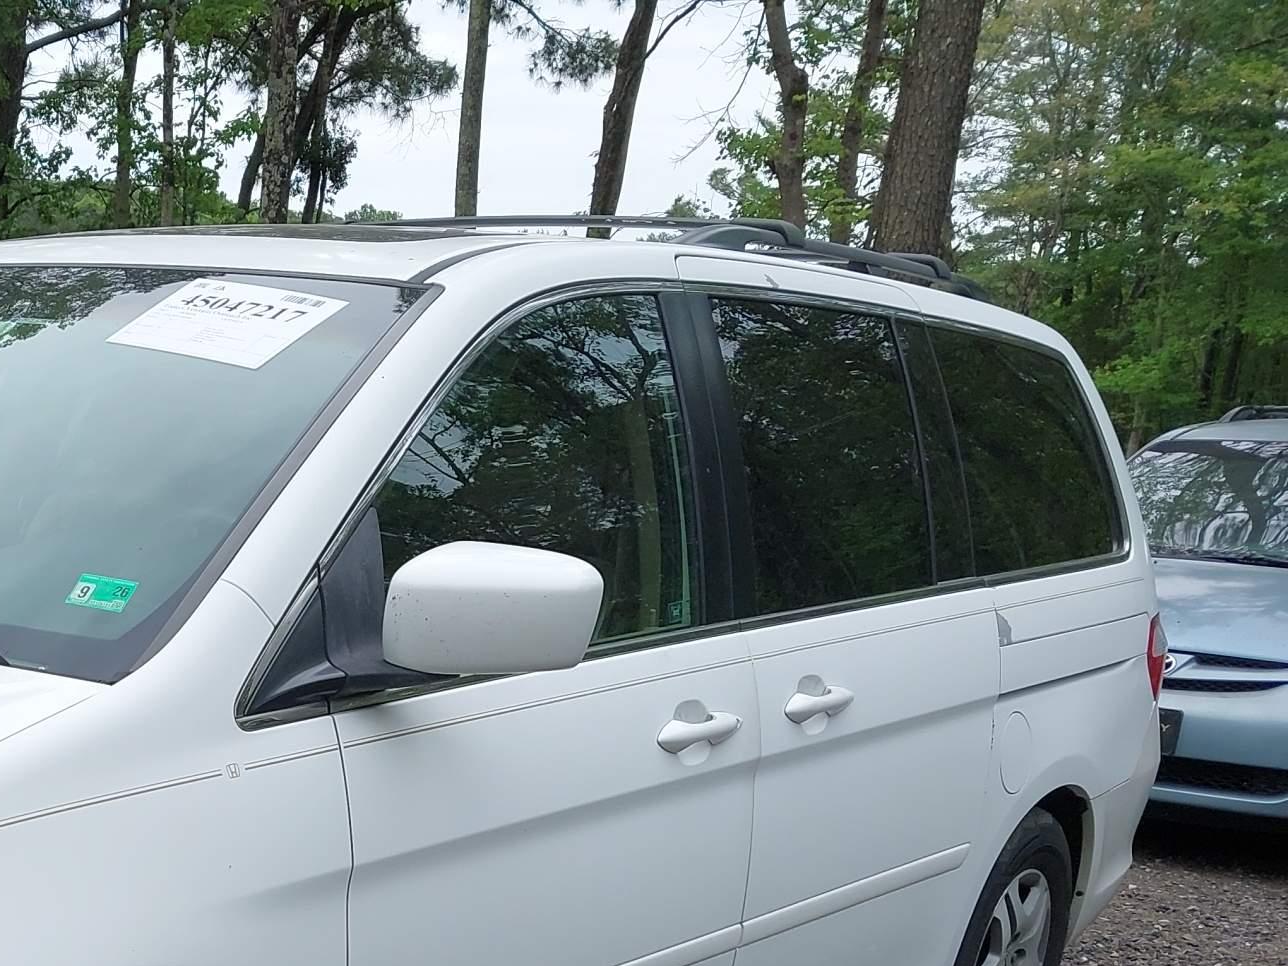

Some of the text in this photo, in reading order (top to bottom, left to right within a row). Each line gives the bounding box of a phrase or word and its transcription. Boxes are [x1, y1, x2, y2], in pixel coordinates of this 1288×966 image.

[181, 294, 309, 322] 45047217
[78, 586, 131, 598] 9 26
